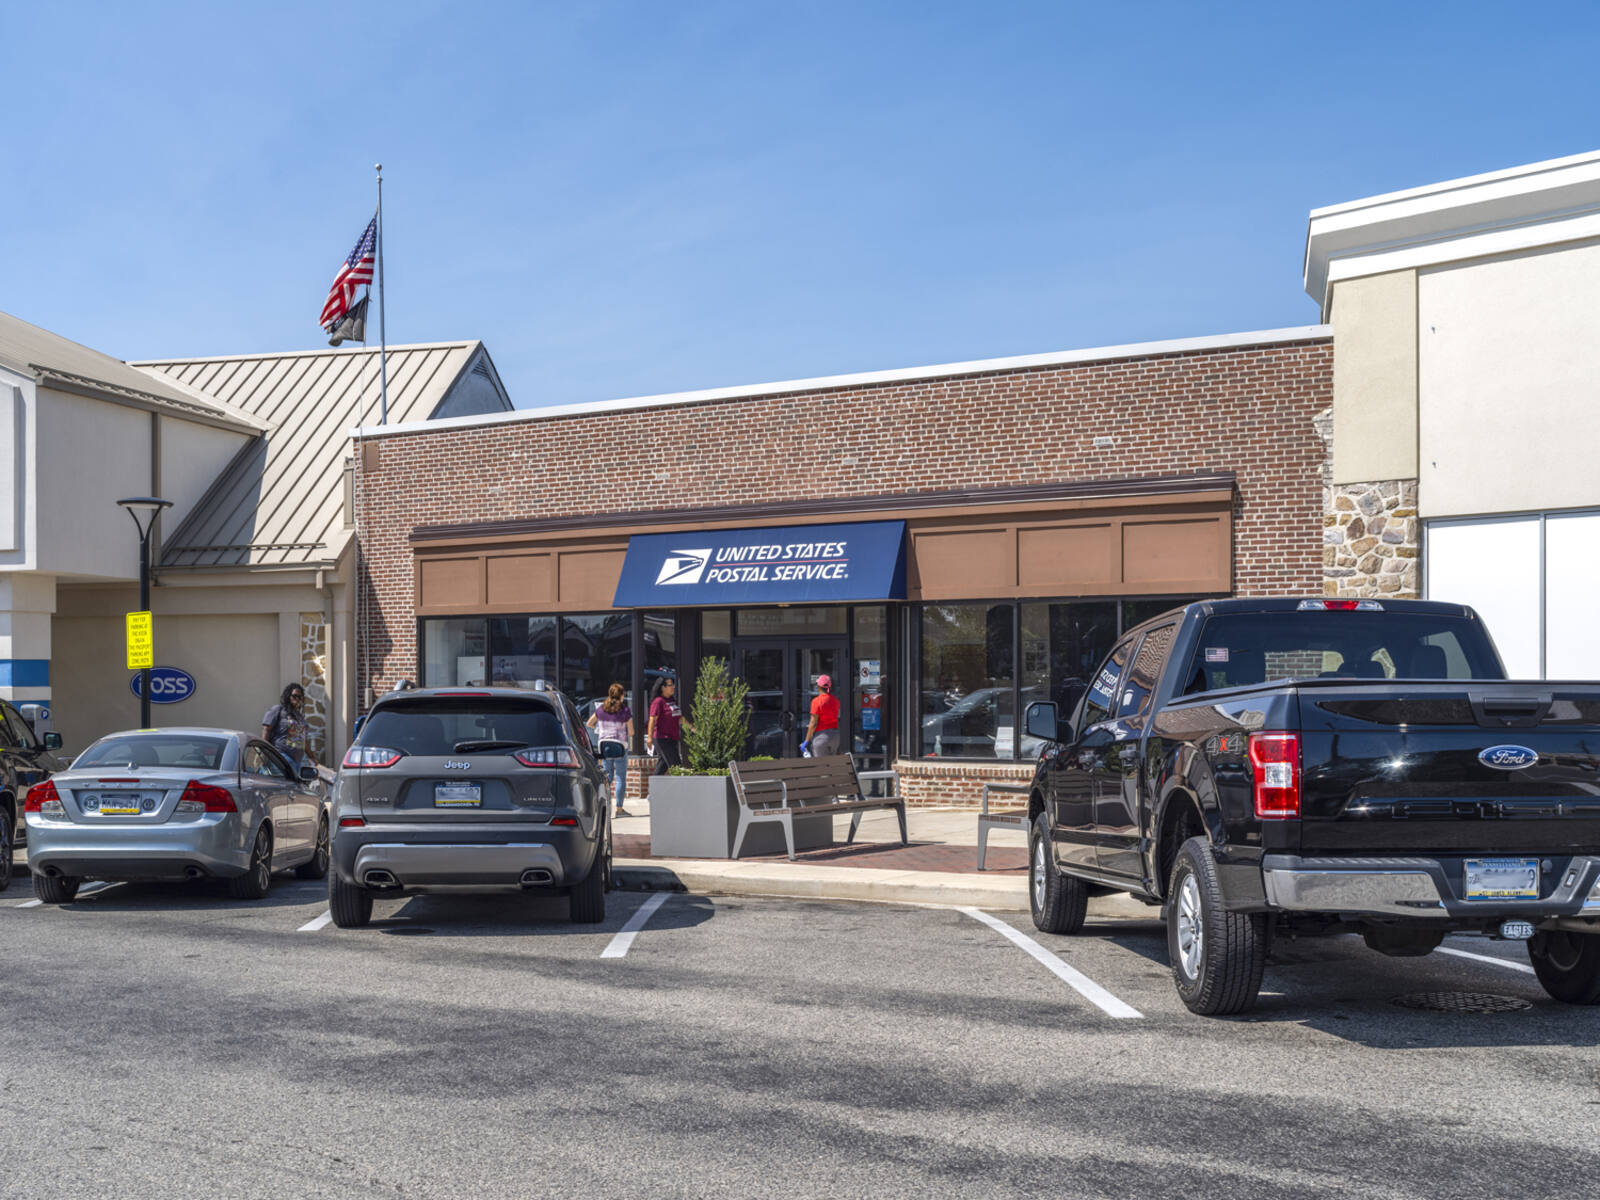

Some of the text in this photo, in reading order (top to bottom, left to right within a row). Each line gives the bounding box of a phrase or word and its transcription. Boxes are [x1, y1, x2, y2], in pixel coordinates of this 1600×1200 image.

[716, 542, 847, 562] UNITED STATES
[705, 567, 769, 583] POSTAL
[139, 677, 188, 694] OSS
[1492, 750, 1526, 764] Ford
[444, 760, 471, 770] Jeep
[1503, 925, 1534, 937] EAGLES
